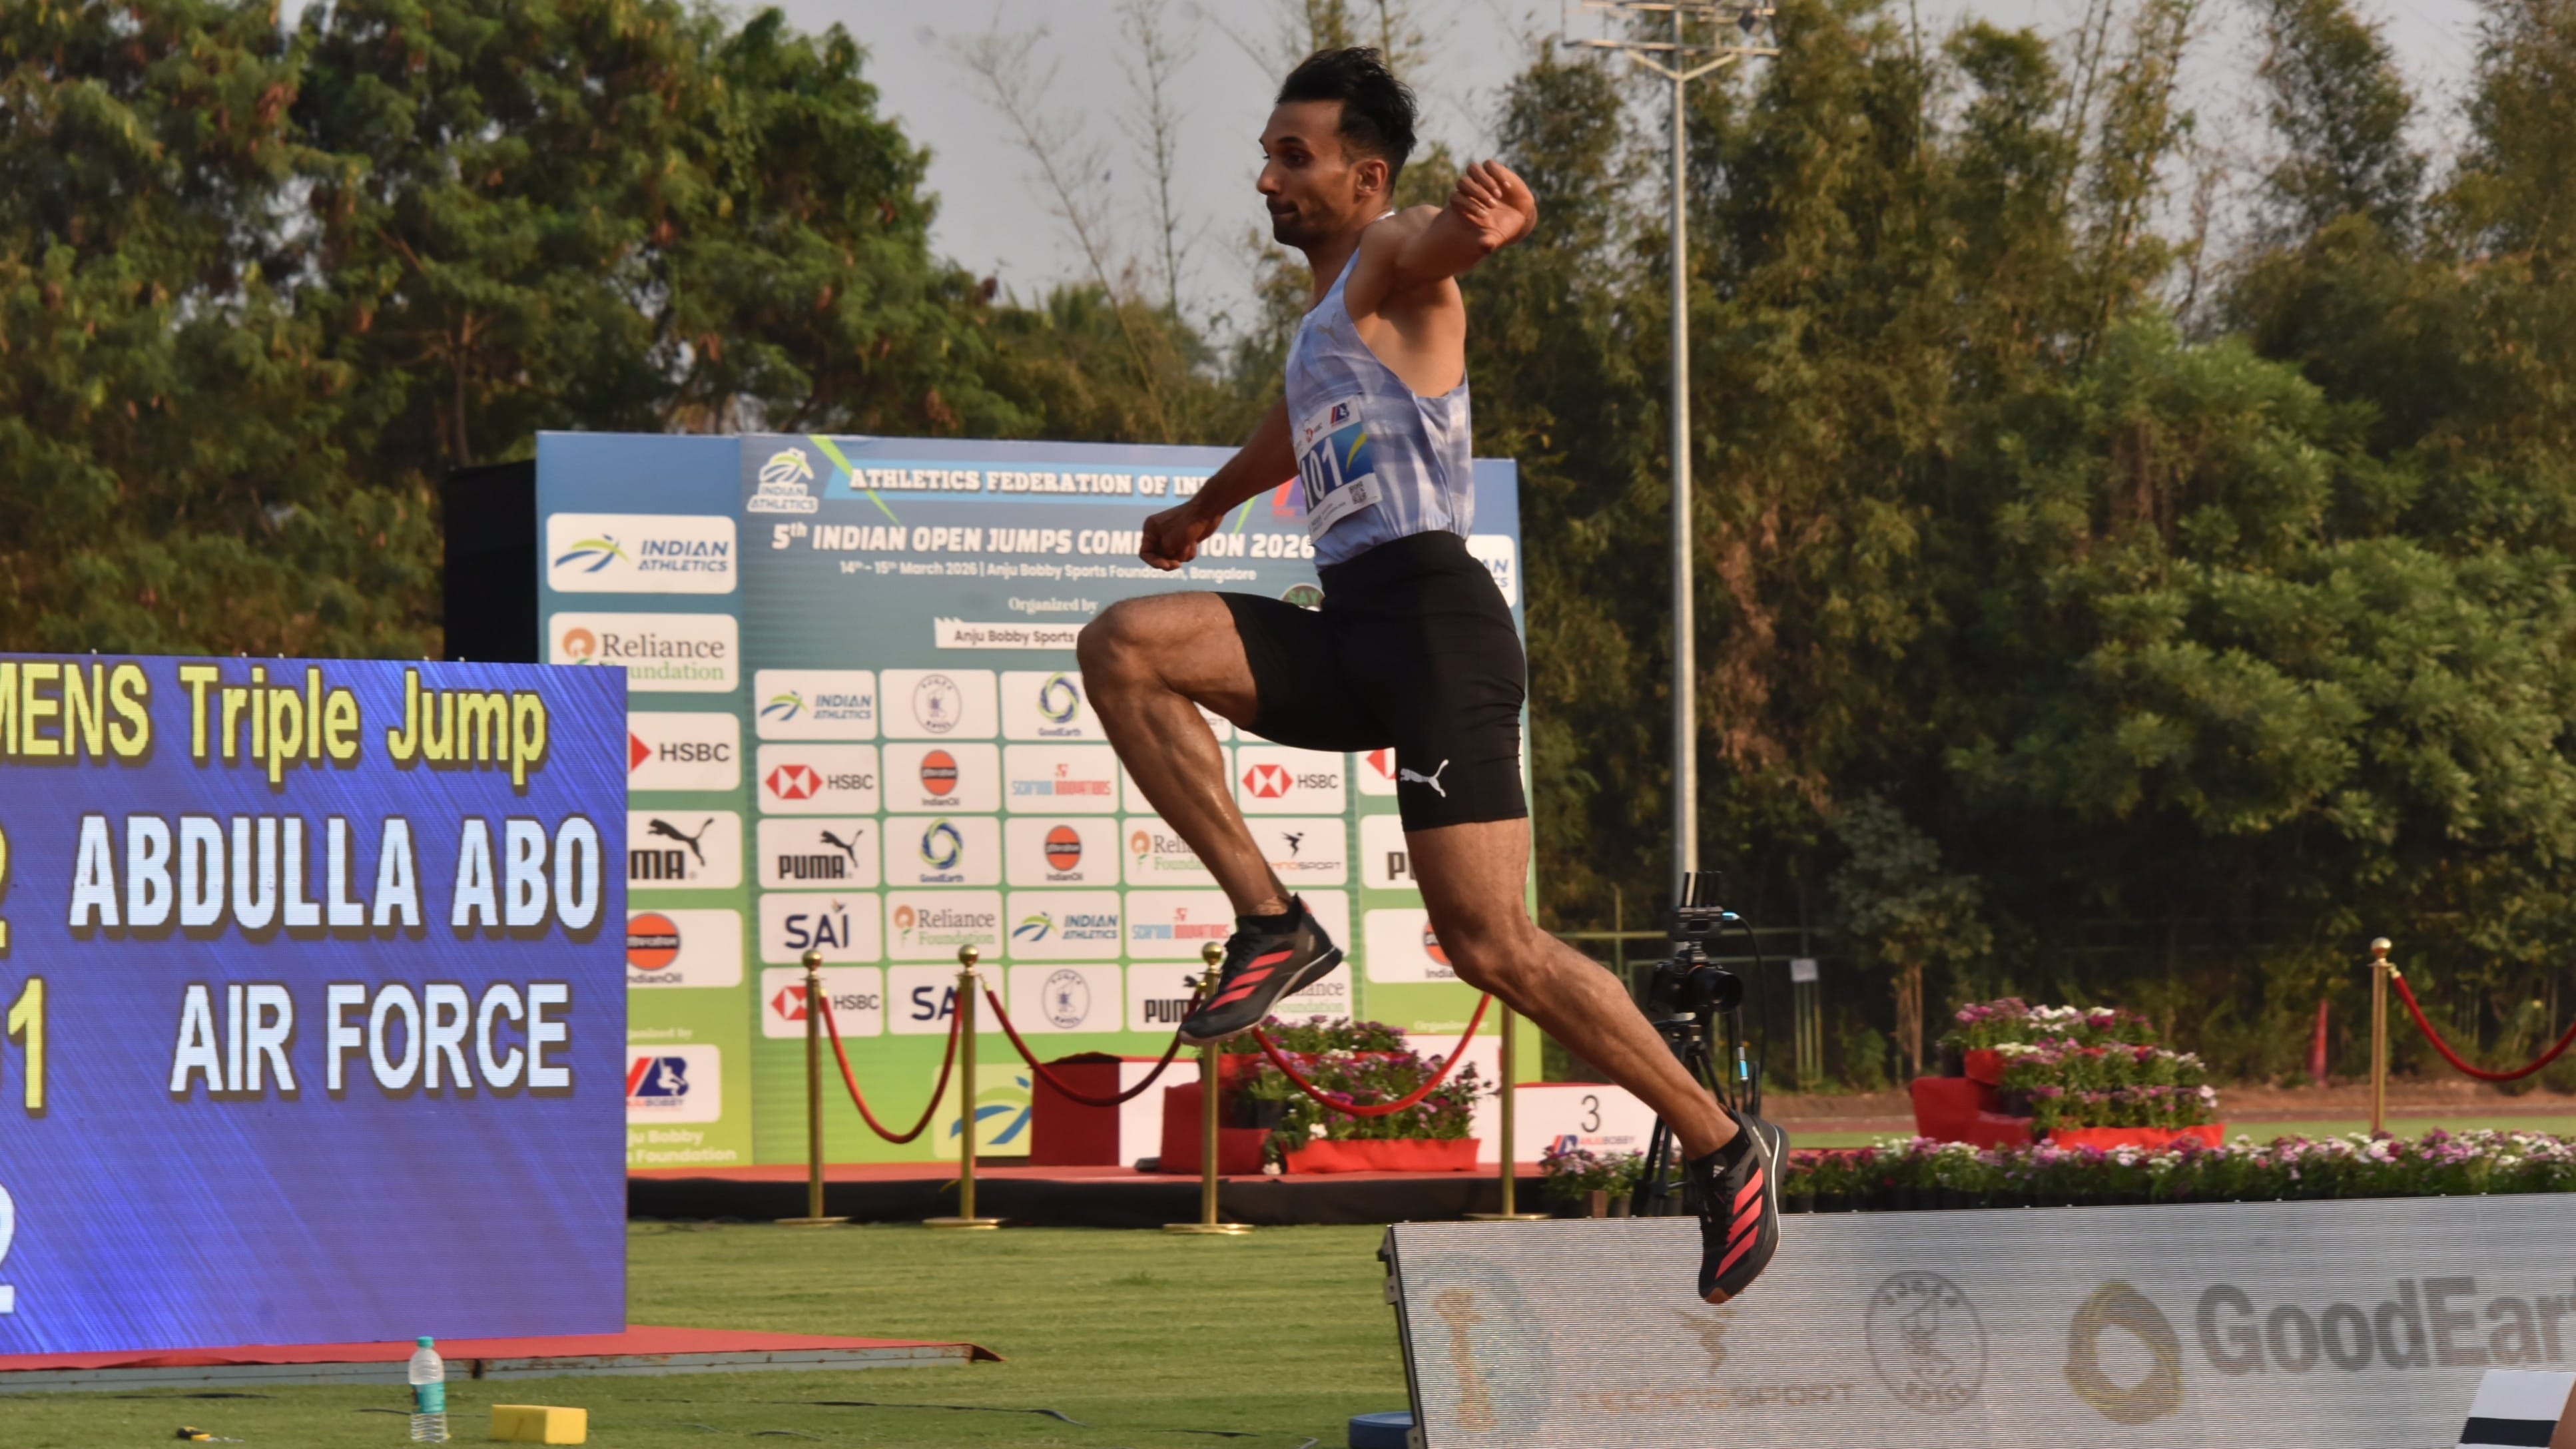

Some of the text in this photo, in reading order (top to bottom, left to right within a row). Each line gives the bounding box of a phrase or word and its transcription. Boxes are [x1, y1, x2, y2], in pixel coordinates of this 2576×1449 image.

[849, 468, 980, 491] ATHLETICS
[986, 470, 1133, 495] FEDERATION
[1137, 474, 1168, 495] OF
[641, 539, 729, 557] INDIAN
[771, 521, 808, 549] 5th
[812, 524, 907, 551] INDIAN
[912, 526, 983, 553] OPEN
[986, 527, 1073, 554] JUMPS
[1249, 533, 1315, 559] 2026
[637, 560, 728, 572] ATHLETICS
[900, 561, 944, 575] March
[987, 563, 1018, 581] Anju
[1020, 563, 1062, 581] Bobby
[1065, 564, 1107, 581] Sports
[1189, 566, 1257, 584] Bangalore
[1081, 598, 1099, 615] by
[601, 633, 725, 658] Reliance
[954, 630, 1075, 645] Anju Bobby Sports
[627, 661, 725, 680] undation
[815, 695, 871, 707] INDIAN
[179, 666, 360, 784] Triple
[387, 669, 546, 786] Jump
[659, 742, 730, 762] HSBC
[827, 774, 874, 790] HSBC
[1297, 774, 1339, 788] HSBC
[922, 797, 960, 806] IndianOil
[1153, 834, 1196, 854] Reli
[69, 814, 420, 930] ABDULLA
[451, 816, 600, 930] ABO
[629, 850, 685, 880] MA
[778, 855, 845, 880] PUMA
[920, 874, 964, 883] GoodEarth
[1046, 872, 1084, 882] IndianOil
[785, 906, 849, 949] SAI
[918, 908, 995, 928] Reliance
[1064, 915, 1118, 928] INDIAN
[918, 931, 995, 946] Foundation
[1062, 930, 1118, 940] ATHLETICS
[627, 972, 683, 984] ndianOil
[833, 994, 879, 1010] HSBC
[911, 986, 956, 1021] SA
[1144, 999, 1191, 1023] PUM
[169, 983, 570, 1093] AIR FORCE
[1580, 1094, 1601, 1133] 3
[648, 1129, 704, 1146] Bobby
[636, 1147, 737, 1163] Foundation
[2196, 1275, 2576, 1376] GoodEar
